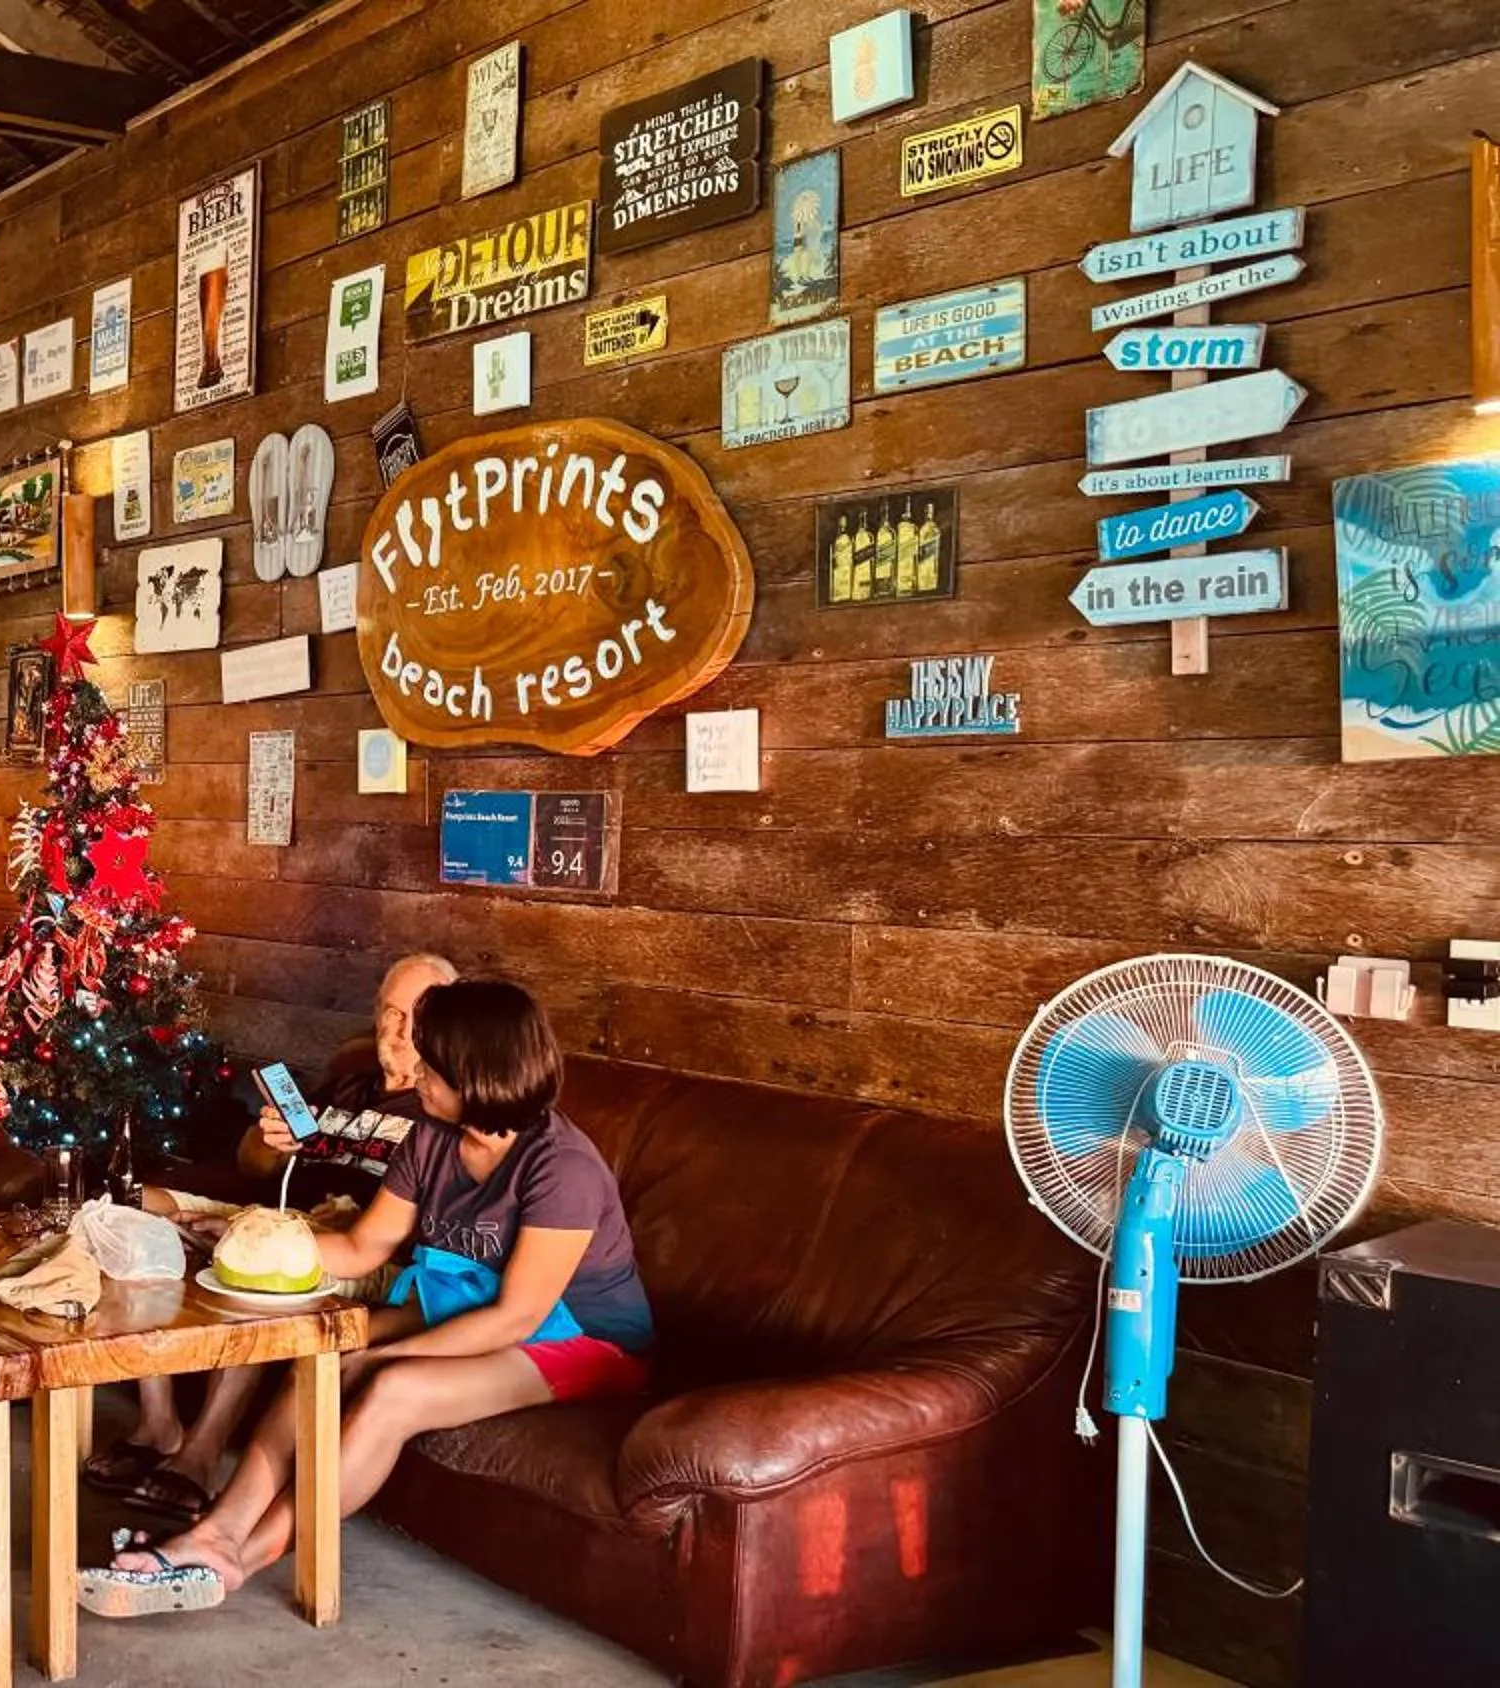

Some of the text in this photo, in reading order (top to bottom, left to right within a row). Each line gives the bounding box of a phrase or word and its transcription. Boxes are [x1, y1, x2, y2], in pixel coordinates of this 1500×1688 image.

[474, 52, 513, 85] WINE
[613, 100, 740, 164] STRETCHED
[645, 111, 675, 131] MIND
[679, 98, 708, 118] THAT
[713, 91, 723, 105] IS
[654, 147, 677, 168] NEW
[680, 124, 739, 157] EXPERIENCE
[907, 142, 984, 185] NO SMOKING
[908, 126, 983, 158] STRICTLY
[621, 172, 641, 189] CAN
[647, 161, 681, 181] NEVER
[685, 154, 699, 167] GO
[703, 143, 731, 161] BACK
[661, 173, 681, 189] ITS
[683, 165, 707, 182] OLD
[1149, 145, 1236, 191] LIFE
[188, 191, 243, 236] BEER
[613, 172, 740, 230] DIMENSIONS
[437, 203, 587, 290] DETOUR
[1098, 219, 1281, 275] isn't about
[449, 269, 587, 332] Dreams
[1102, 264, 1276, 325] Waiting for the
[903, 301, 996, 334] LIFE IS GOOD
[912, 323, 985, 349] AT THE
[780, 327, 847, 362] THERAPY
[895, 336, 1005, 373] BEACH
[1120, 334, 1244, 366] storm
[743, 424, 797, 445] PRACTICED
[1091, 464, 1270, 493] it's about learning
[1115, 503, 1239, 550] to dance
[472, 564, 527, 610] Feb,
[1087, 564, 1269, 612] in the rain
[1391, 558, 1419, 602] is
[380, 598, 677, 721] beach resort
[964, 655, 994, 697] MY
[506, 855, 525, 868] 9.4
[551, 850, 583, 877] 9.4
